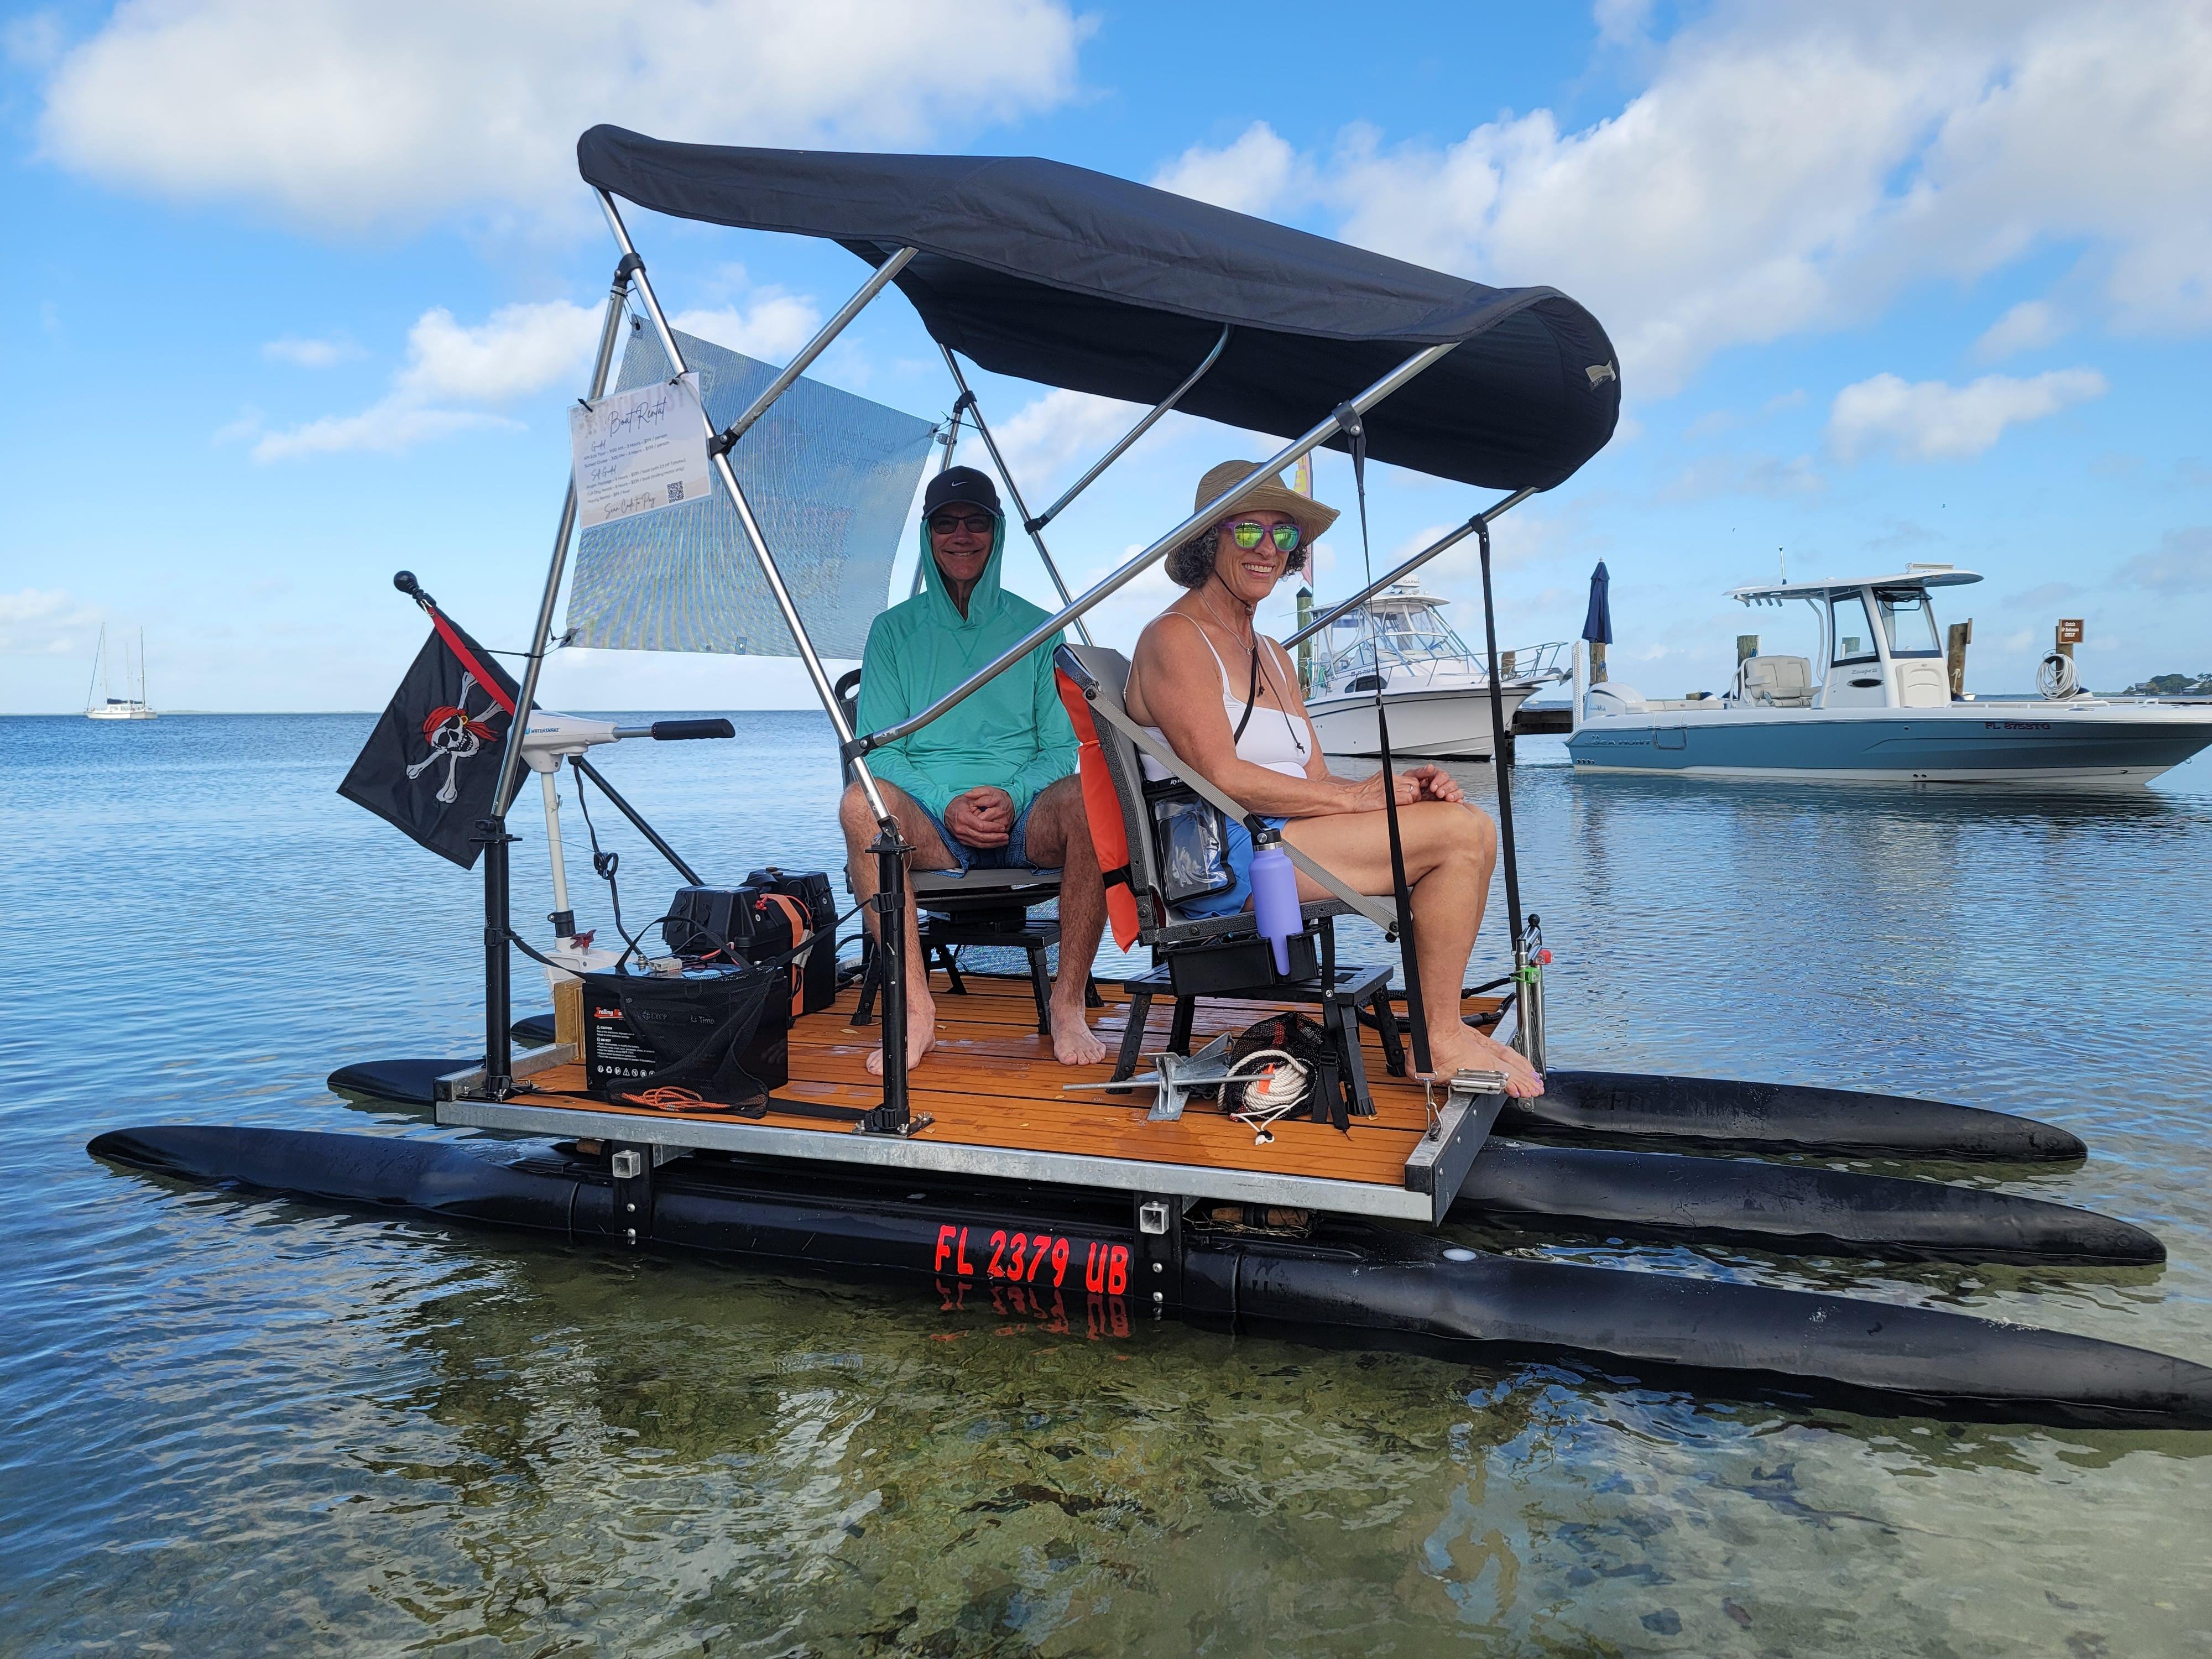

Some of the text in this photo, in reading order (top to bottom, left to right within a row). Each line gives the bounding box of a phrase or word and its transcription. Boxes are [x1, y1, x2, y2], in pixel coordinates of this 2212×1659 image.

[608, 396, 667, 437] Boat Rental
[935, 1224, 1129, 1295] FL 2379 UB
